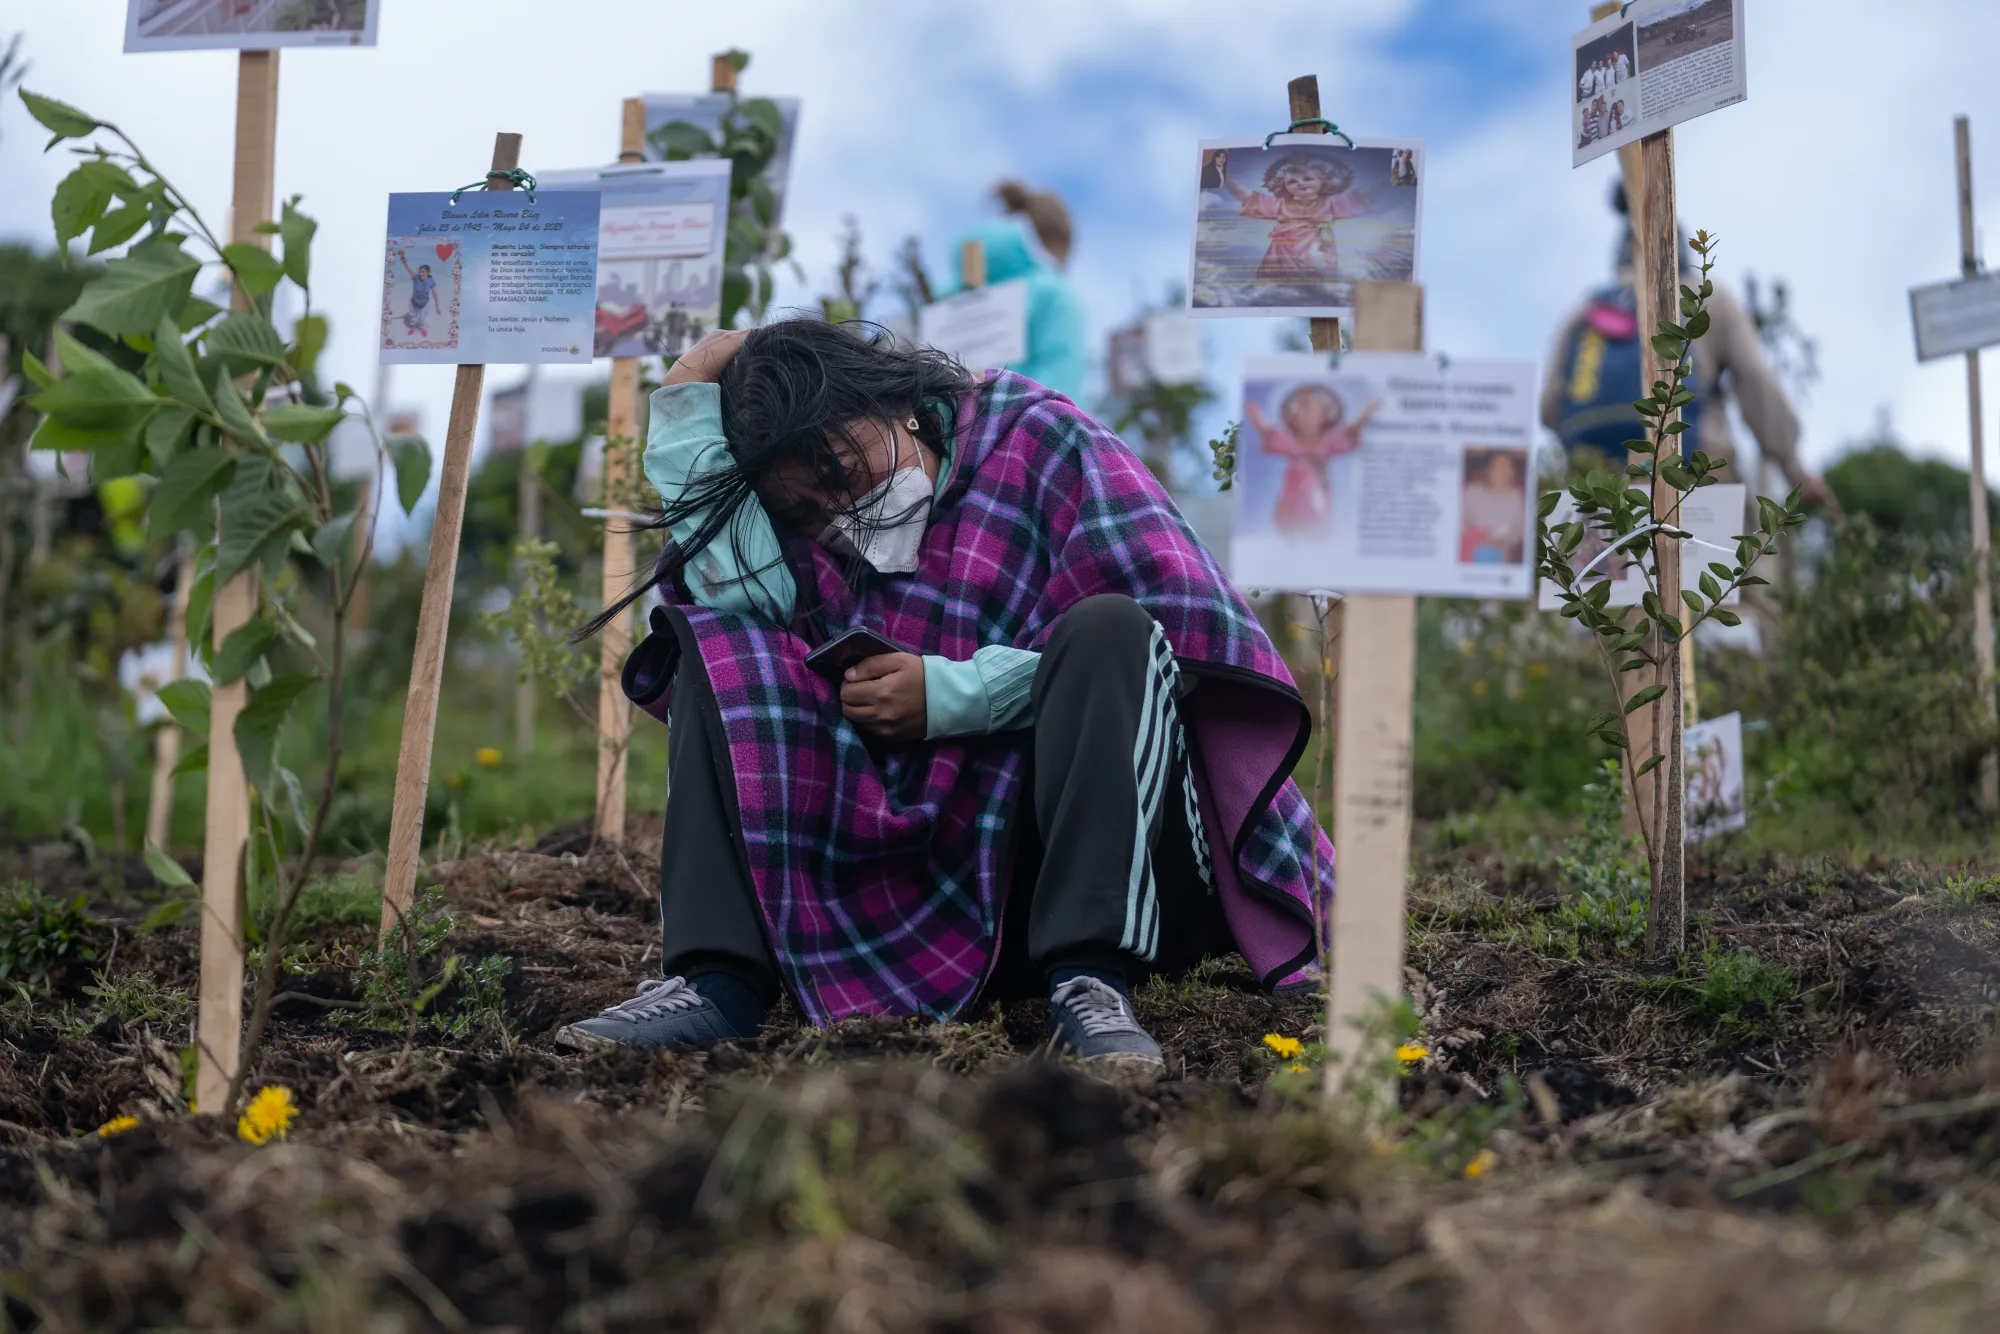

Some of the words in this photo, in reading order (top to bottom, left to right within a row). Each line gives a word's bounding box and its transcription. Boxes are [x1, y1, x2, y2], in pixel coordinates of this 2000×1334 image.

[442, 210, 467, 219] Blanca
[494, 210, 518, 218] Rivera
[416, 223, 436, 235] Julio
[493, 222, 516, 232] Mayo
[518, 222, 530, 231] 24
[544, 222, 564, 231] 2021
